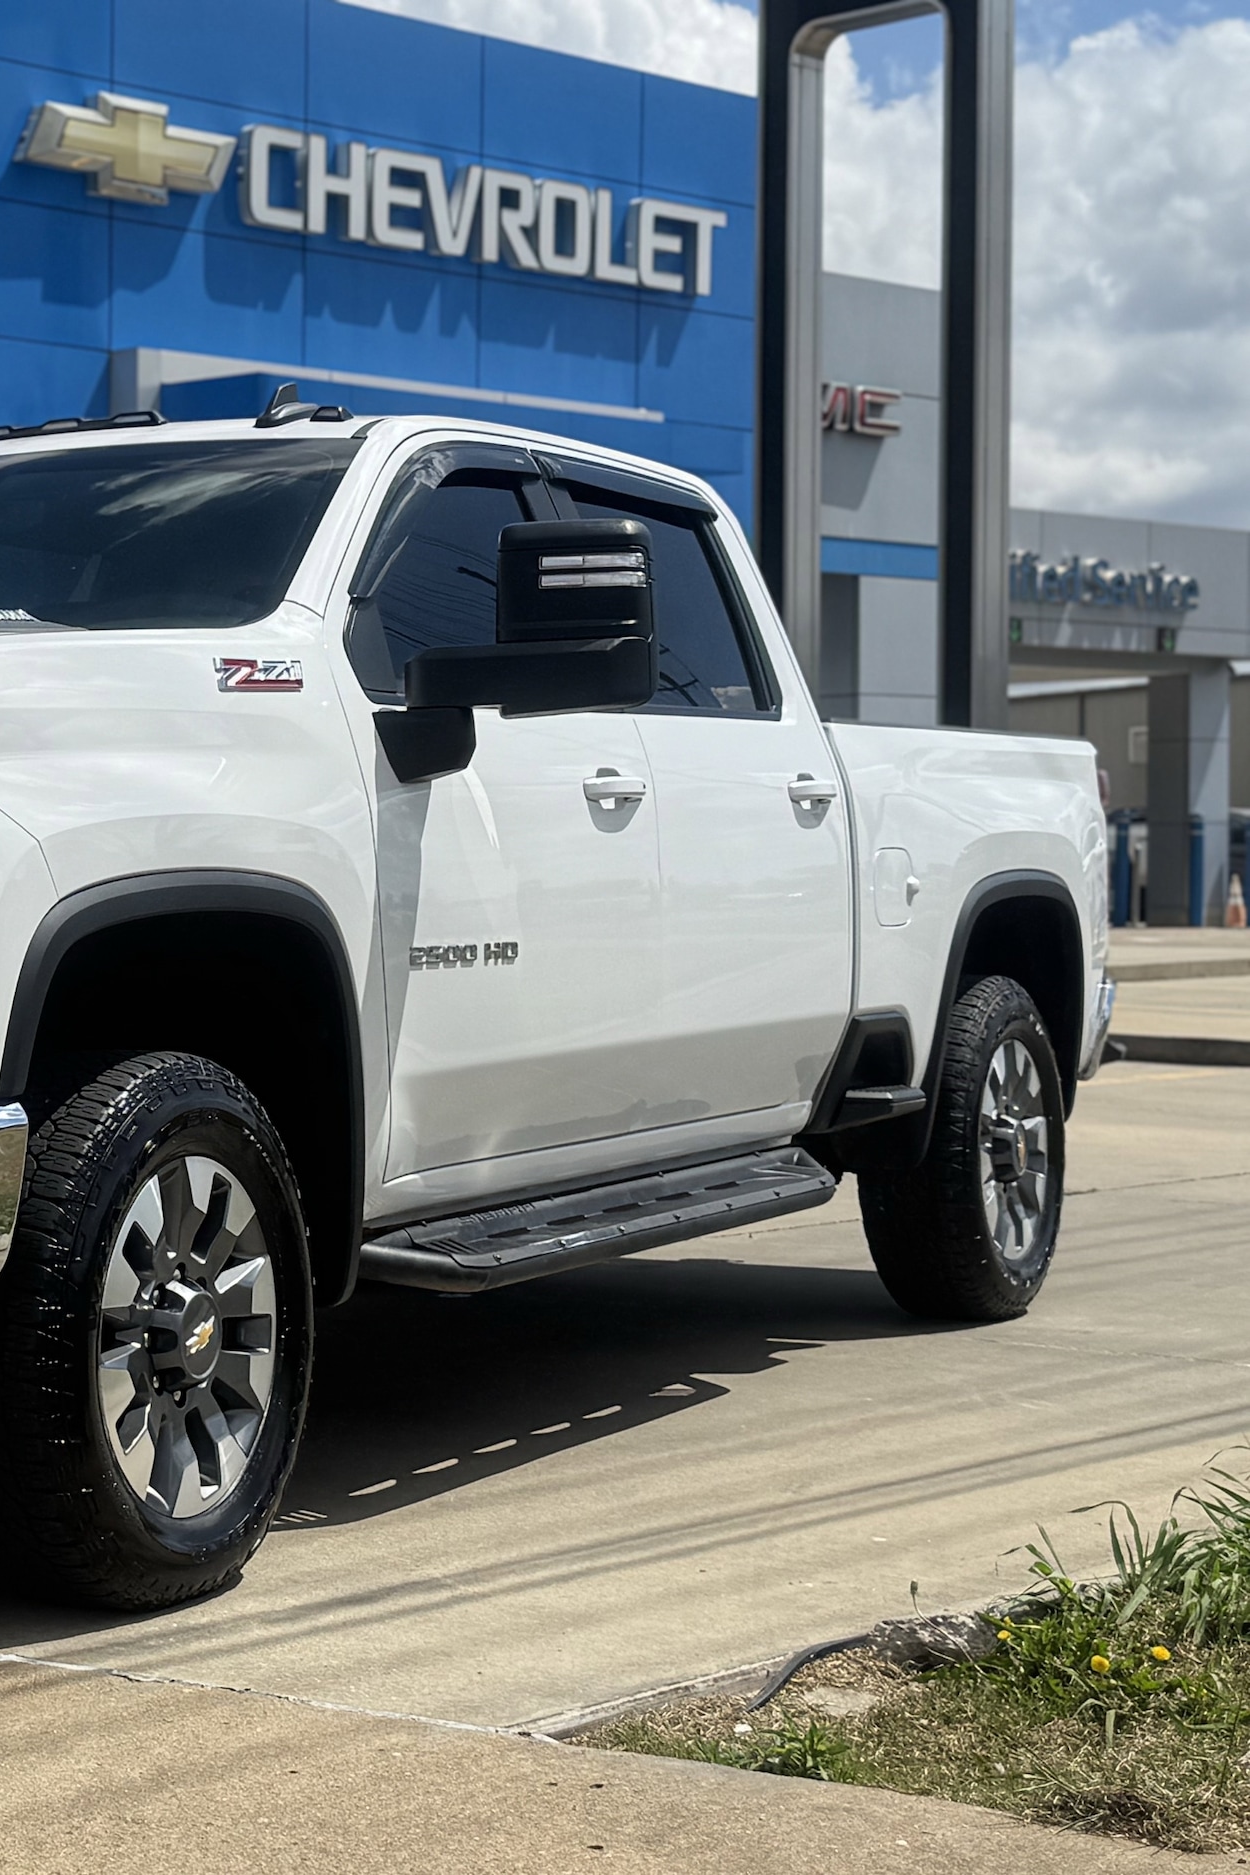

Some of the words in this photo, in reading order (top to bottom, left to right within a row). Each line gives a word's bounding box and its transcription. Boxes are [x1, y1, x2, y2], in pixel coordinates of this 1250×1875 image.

[239, 124, 727, 296] CHEVROLET
[1083, 557, 1200, 611] Service
[213, 657, 303, 692] Z71
[409, 944, 477, 967] 2500
[483, 941, 518, 961] HD
